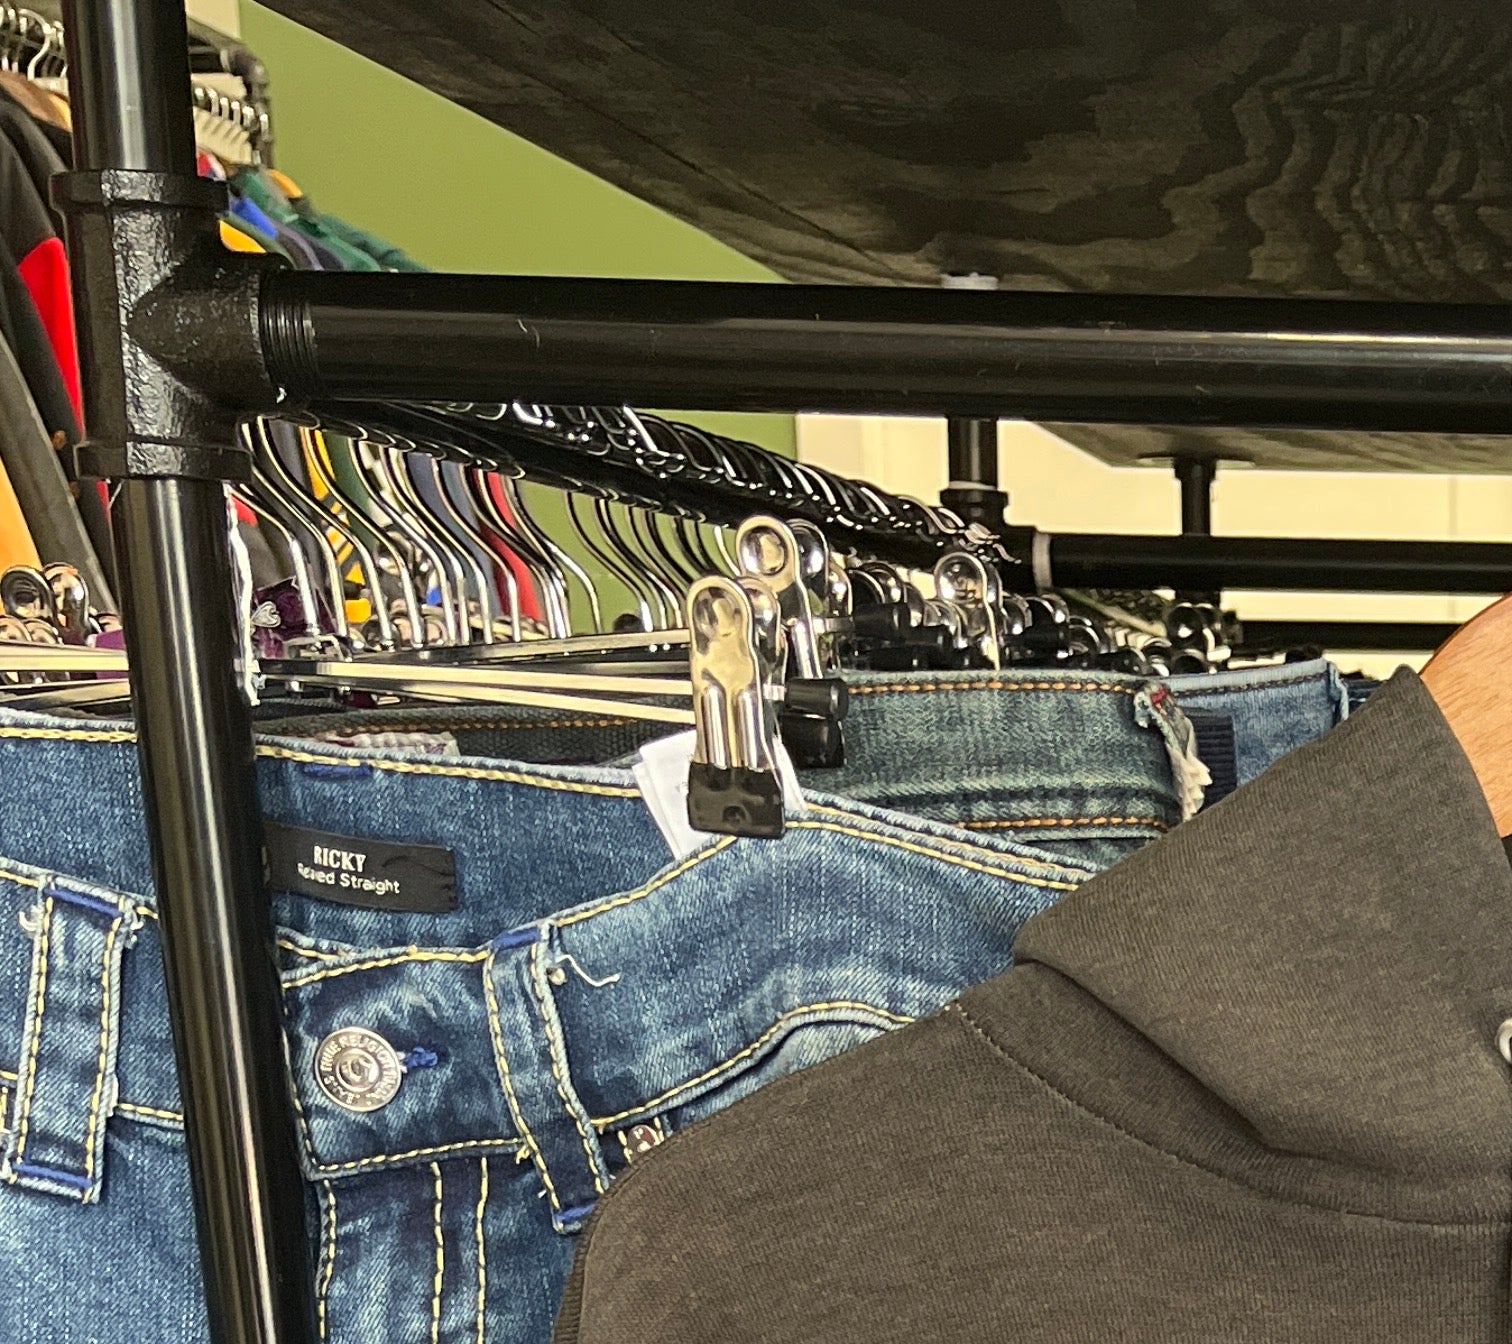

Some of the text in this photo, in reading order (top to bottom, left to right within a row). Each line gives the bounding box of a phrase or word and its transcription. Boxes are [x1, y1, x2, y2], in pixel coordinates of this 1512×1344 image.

[313, 845, 367, 873] RICKY
[339, 872, 400, 895] Straight
[338, 1035, 397, 1070] RELIGION
